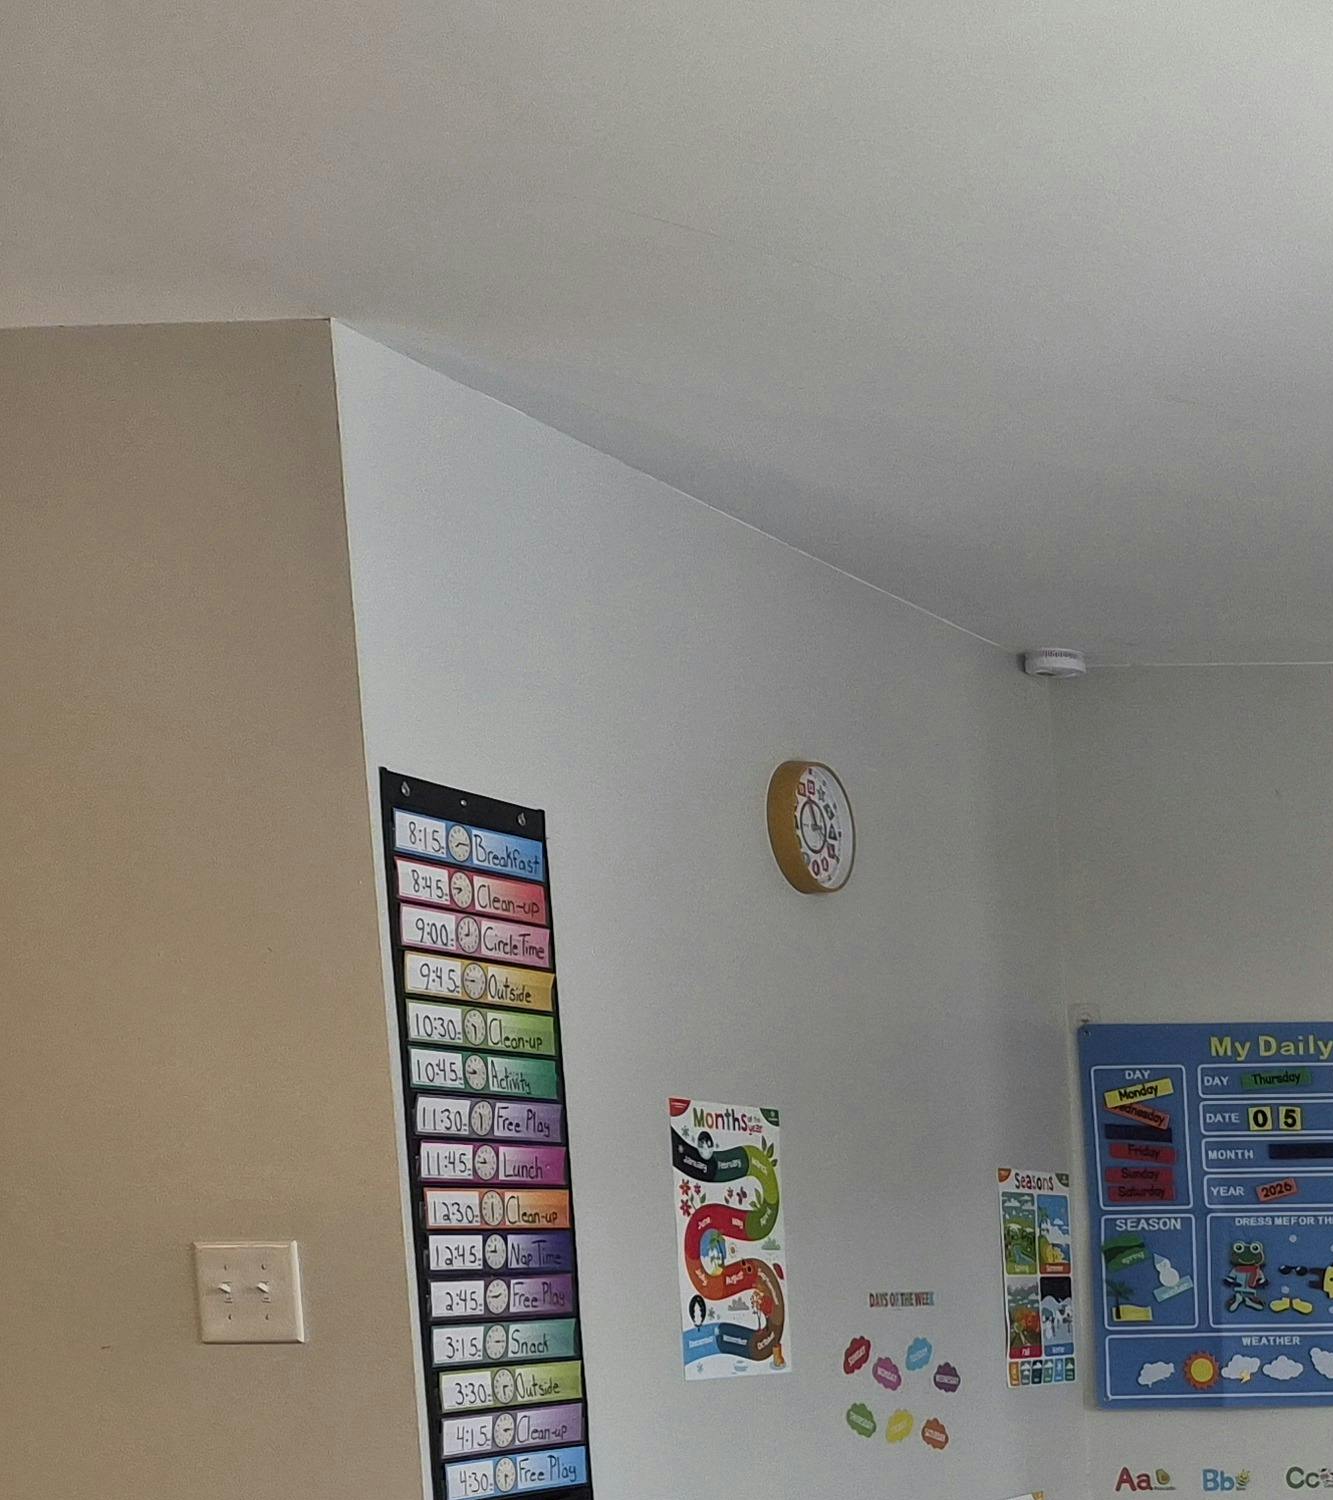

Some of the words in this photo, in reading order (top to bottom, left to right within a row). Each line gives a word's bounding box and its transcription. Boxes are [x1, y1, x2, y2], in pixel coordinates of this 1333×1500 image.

[474, 834, 539, 873] Breakfast
[477, 884, 539, 917] Clean-up
[483, 927, 518, 956] Circle
[519, 934, 544, 960] Time
[488, 974, 531, 1003] Outside
[489, 1018, 542, 1051] Clean-up
[1210, 1035, 1250, 1061] My
[1258, 1034, 1333, 1060] Daily
[492, 1060, 531, 1095] Activity
[1125, 1069, 1150, 1081] DAY
[1203, 1075, 1230, 1087] DAY
[1251, 1071, 1301, 1087] Thursday
[1118, 1084, 1159, 1102] Monday
[497, 1107, 521, 1134] Free
[526, 1109, 550, 1139] Play
[693, 1107, 748, 1131] Months
[1205, 1112, 1241, 1124] DATE
[503, 1152, 543, 1179] Lunch
[1207, 1149, 1255, 1161] MONTH
[1014, 1172, 1055, 1192] Seasons
[1210, 1186, 1246, 1197] YEAR
[1260, 1180, 1293, 1199] 2026
[506, 1196, 558, 1224] Clean-up
[1234, 1215, 1273, 1227] DRESS
[1115, 1217, 1183, 1232] SEASON
[510, 1244, 534, 1265] Nap
[532, 1240, 561, 1264] Time
[513, 1283, 538, 1309] Free
[542, 1282, 566, 1306] Play
[869, 1292, 888, 1308] DAYS
[511, 1329, 549, 1354] Snack
[1241, 1335, 1301, 1347] WEATHER
[516, 1373, 560, 1400] Outside
[516, 1415, 567, 1443] Clean-up
[519, 1458, 544, 1482] Free
[551, 1455, 576, 1481] Play
[1115, 1466, 1153, 1492] Aa
[1202, 1468, 1235, 1492] Bb
[1286, 1466, 1320, 1489] Cc
